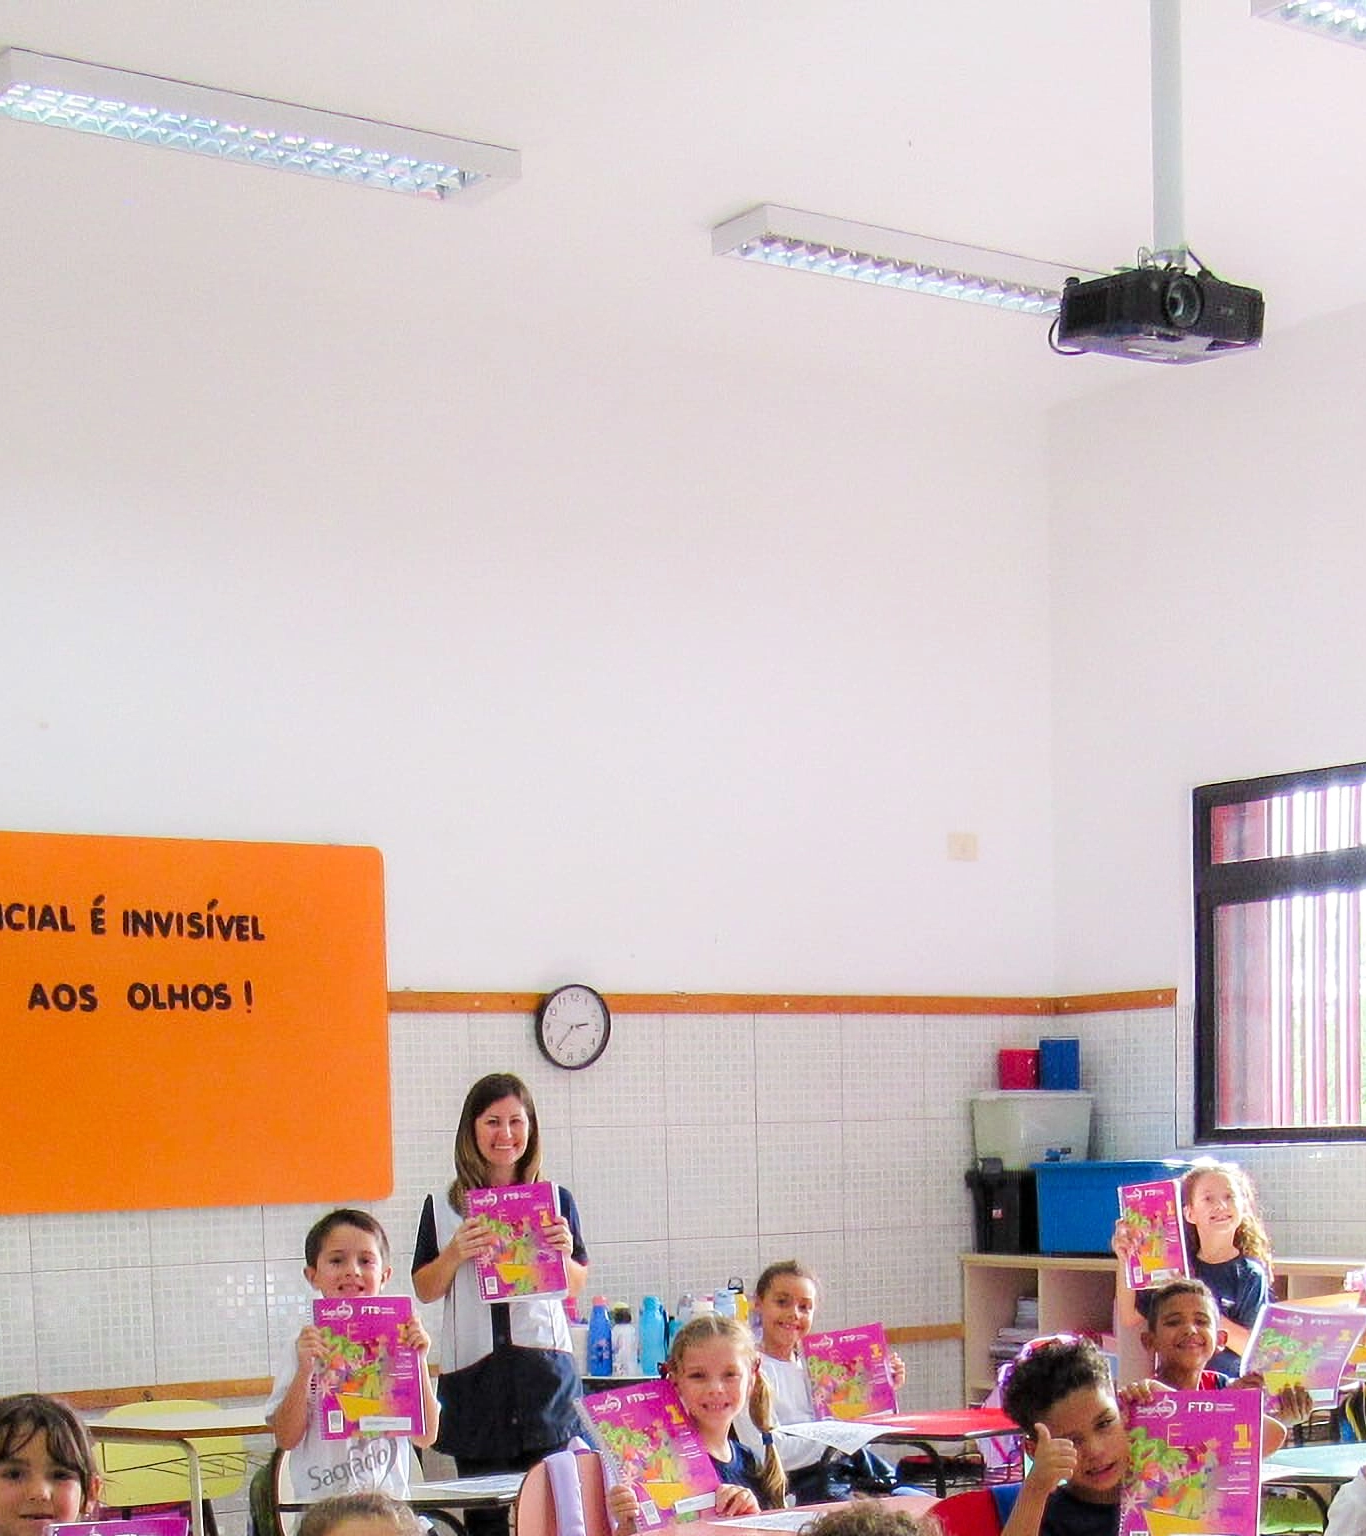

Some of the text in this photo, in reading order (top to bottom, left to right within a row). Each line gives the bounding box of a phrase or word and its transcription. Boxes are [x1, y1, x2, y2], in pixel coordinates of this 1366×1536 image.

[90, 894, 106, 936] É
[122, 898, 266, 943] INVISÍVEL
[27, 982, 99, 1013] AOS
[666, 1404, 685, 1424] 1
[1188, 1401, 1214, 1413] FTD
[1233, 1423, 1252, 1449] 1
[308, 1443, 388, 1491] Sagrado
